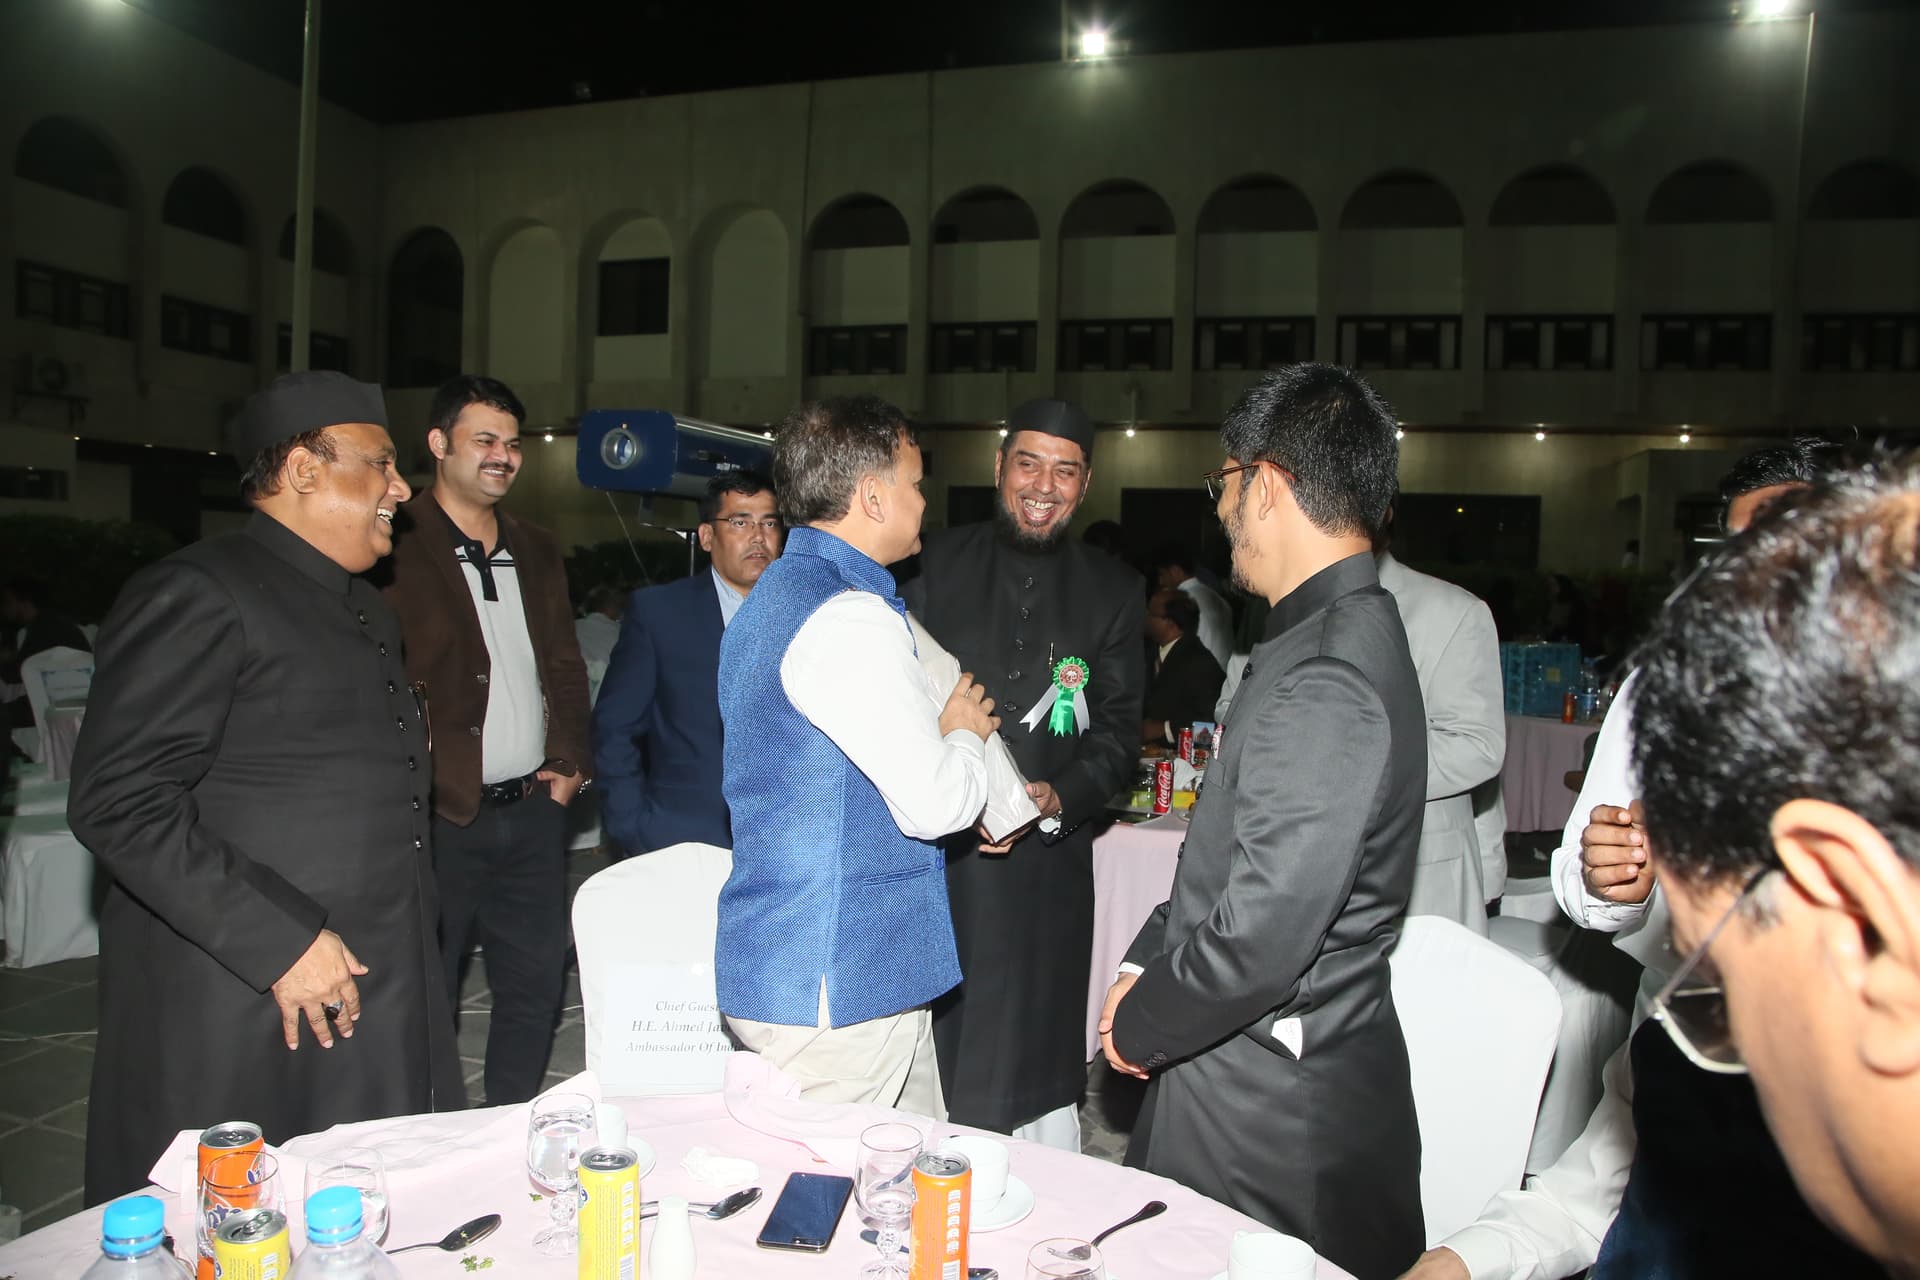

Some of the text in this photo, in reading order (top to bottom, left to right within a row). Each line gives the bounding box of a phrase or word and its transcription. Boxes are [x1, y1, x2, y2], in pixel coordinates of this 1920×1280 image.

[655, 1000, 686, 1013] Chief
[631, 1020, 657, 1032] H.E.
[660, 1020, 704, 1032] Ahmed
[625, 1041, 697, 1052] Ambassador
[699, 1042, 714, 1055] Of
